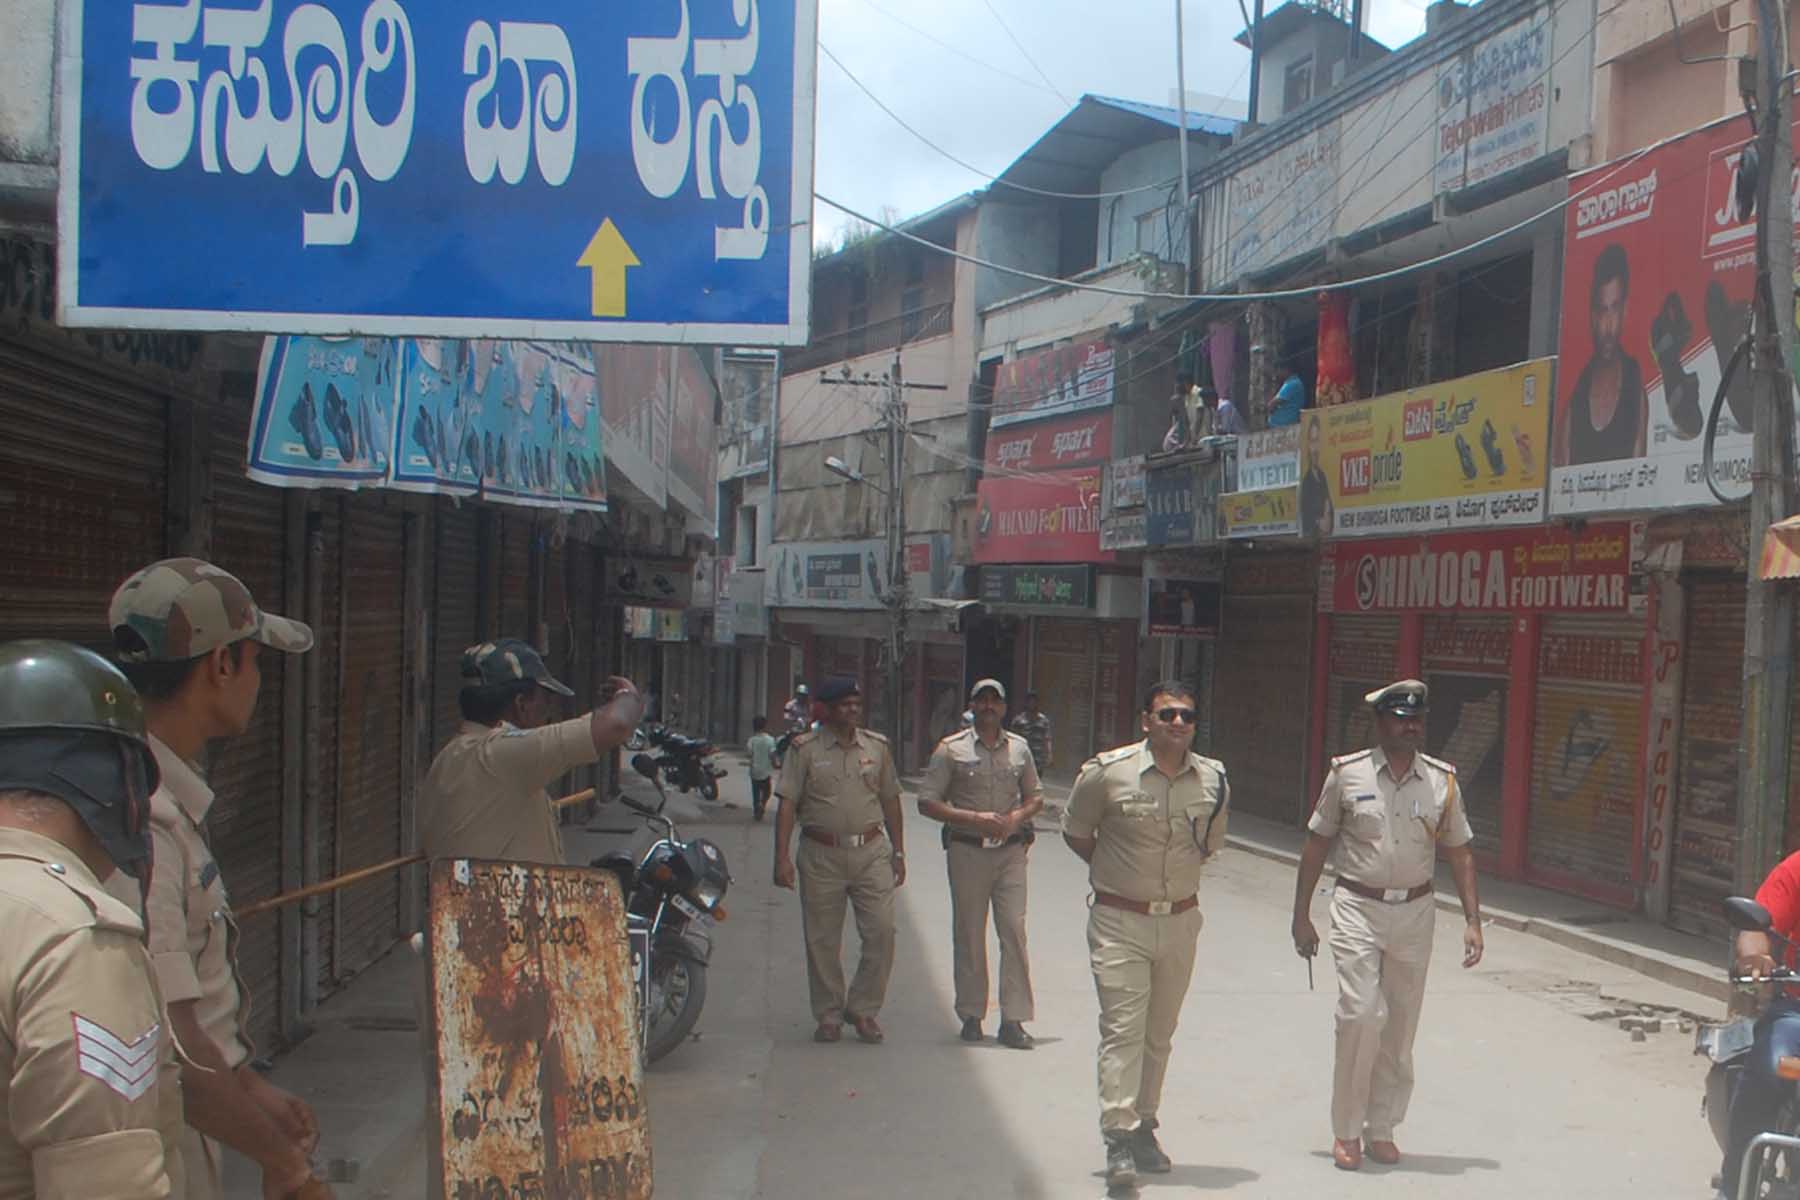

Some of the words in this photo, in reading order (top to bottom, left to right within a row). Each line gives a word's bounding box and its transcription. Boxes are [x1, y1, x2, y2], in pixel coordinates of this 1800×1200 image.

[462, 19, 578, 186] ಬಾ
[1342, 455, 1369, 488] VKC
[1373, 446, 1403, 484] pride
[1712, 458, 1753, 481] HIMOGA
[1356, 511, 1388, 527] SHIMOGA
[1390, 505, 1431, 524] FOOTWEAR
[1355, 549, 1507, 610] SHIMOGA
[1510, 574, 1625, 608] FOOTWEAR
